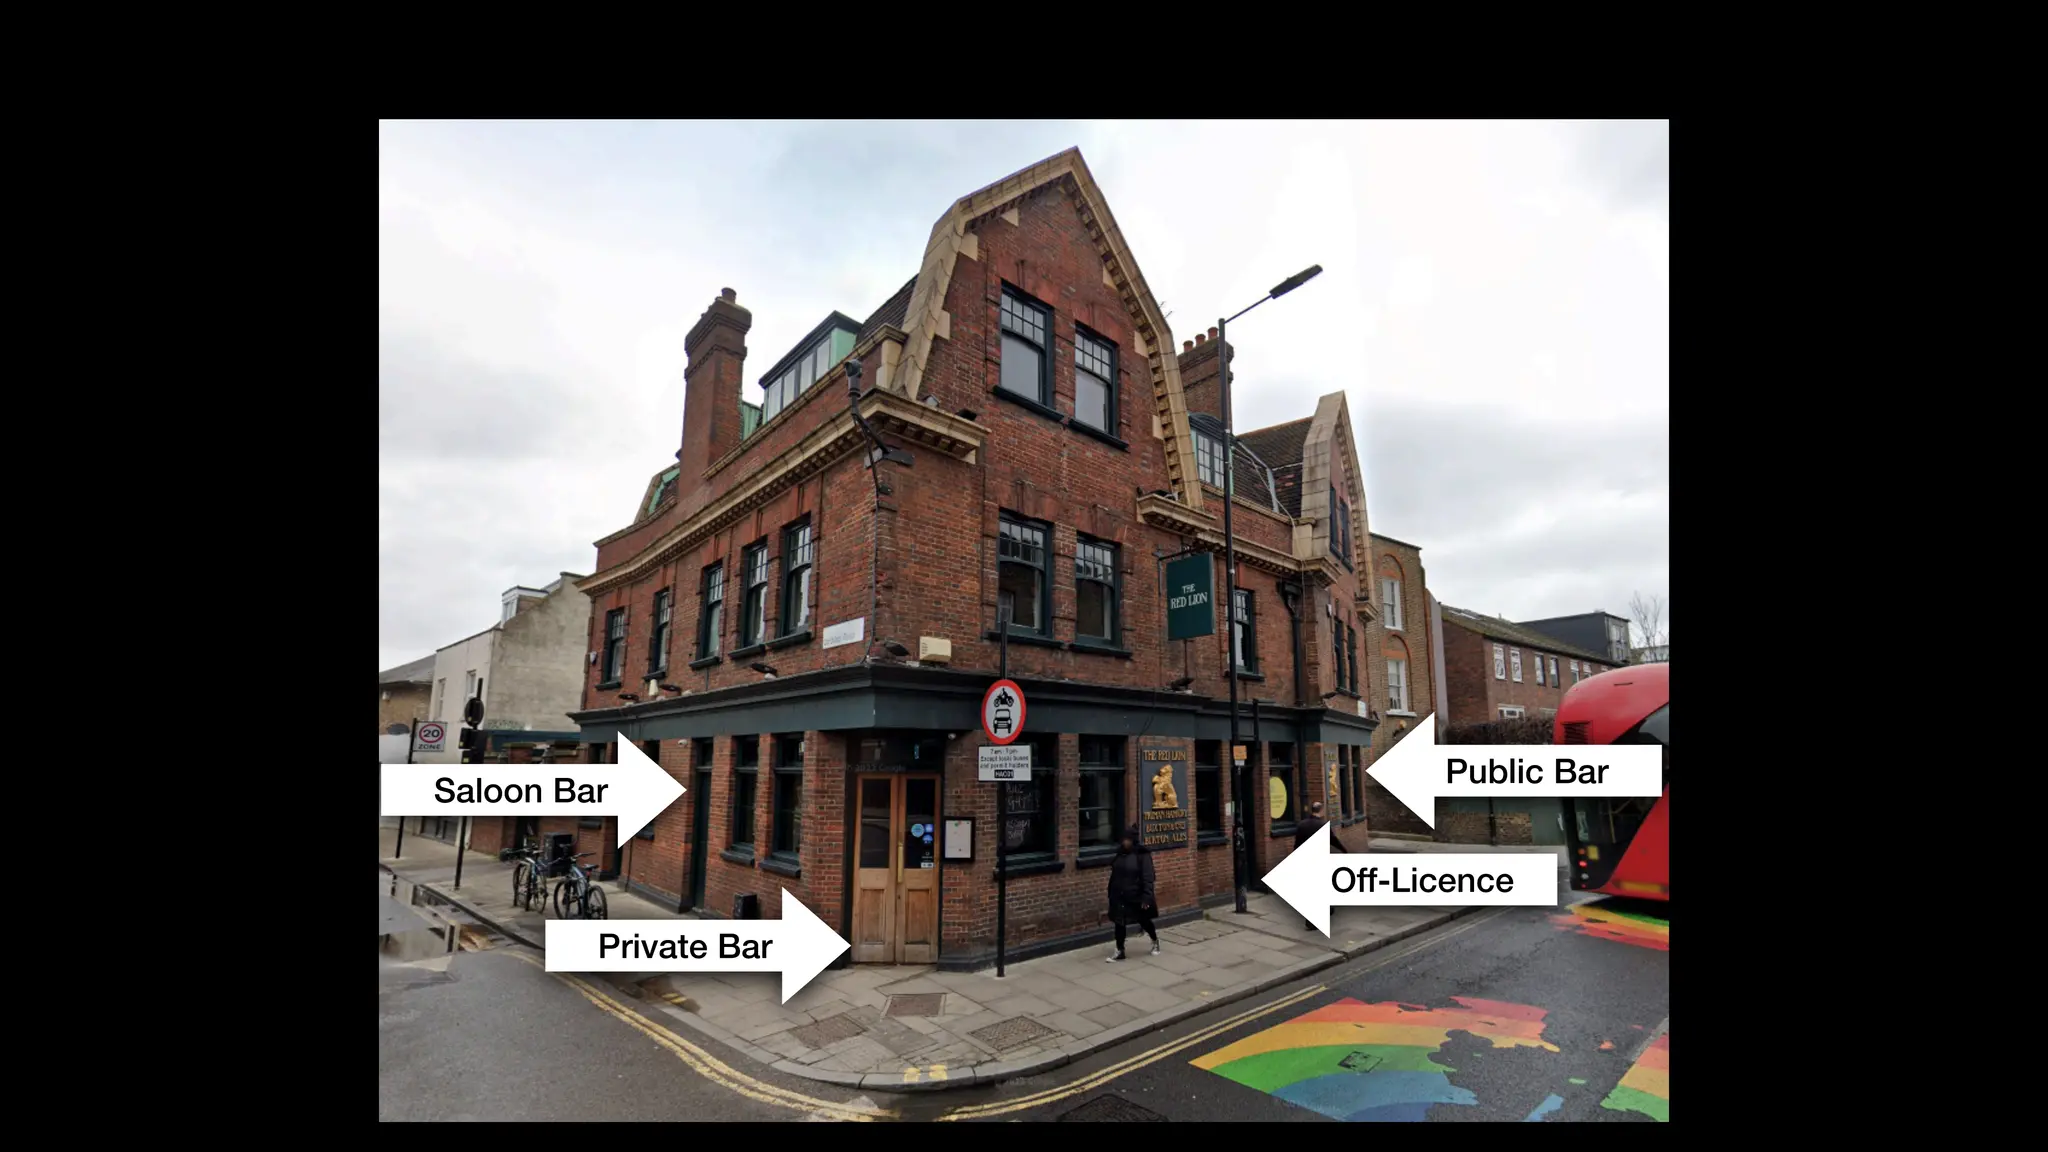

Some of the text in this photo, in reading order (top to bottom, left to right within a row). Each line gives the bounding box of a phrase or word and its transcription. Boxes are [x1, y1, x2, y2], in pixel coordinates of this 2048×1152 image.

[1182, 584, 1195, 594] THE
[1171, 592, 1208, 609] RED LION
[423, 730, 440, 738] 20
[1143, 750, 1186, 760] THE RED LION
